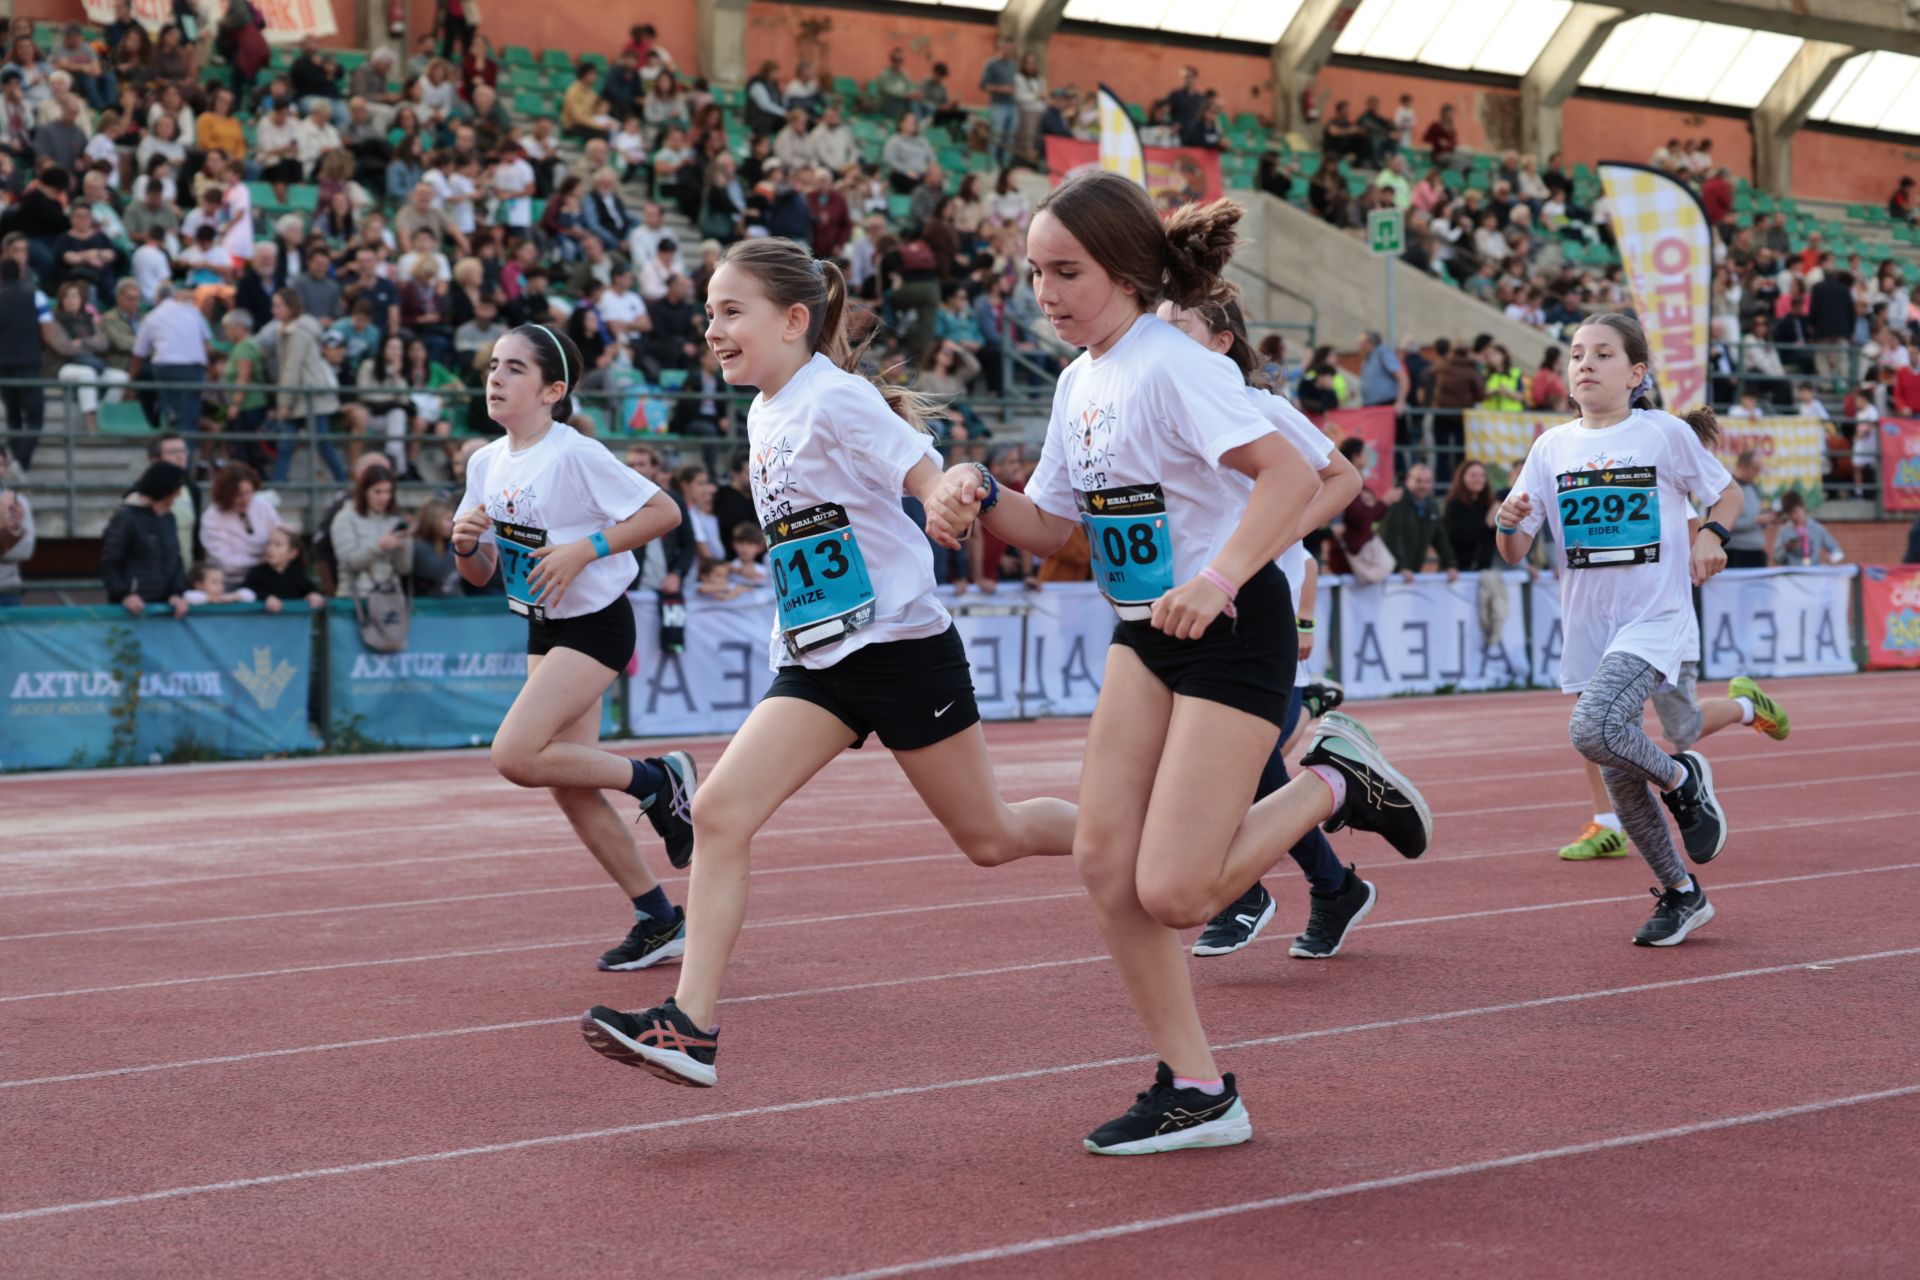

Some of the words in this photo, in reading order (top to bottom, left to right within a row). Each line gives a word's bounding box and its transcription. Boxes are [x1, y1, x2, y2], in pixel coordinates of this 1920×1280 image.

[1561, 493, 1650, 526] 2292
[1588, 526, 1620, 536] EIDER
[773, 539, 849, 598] 013
